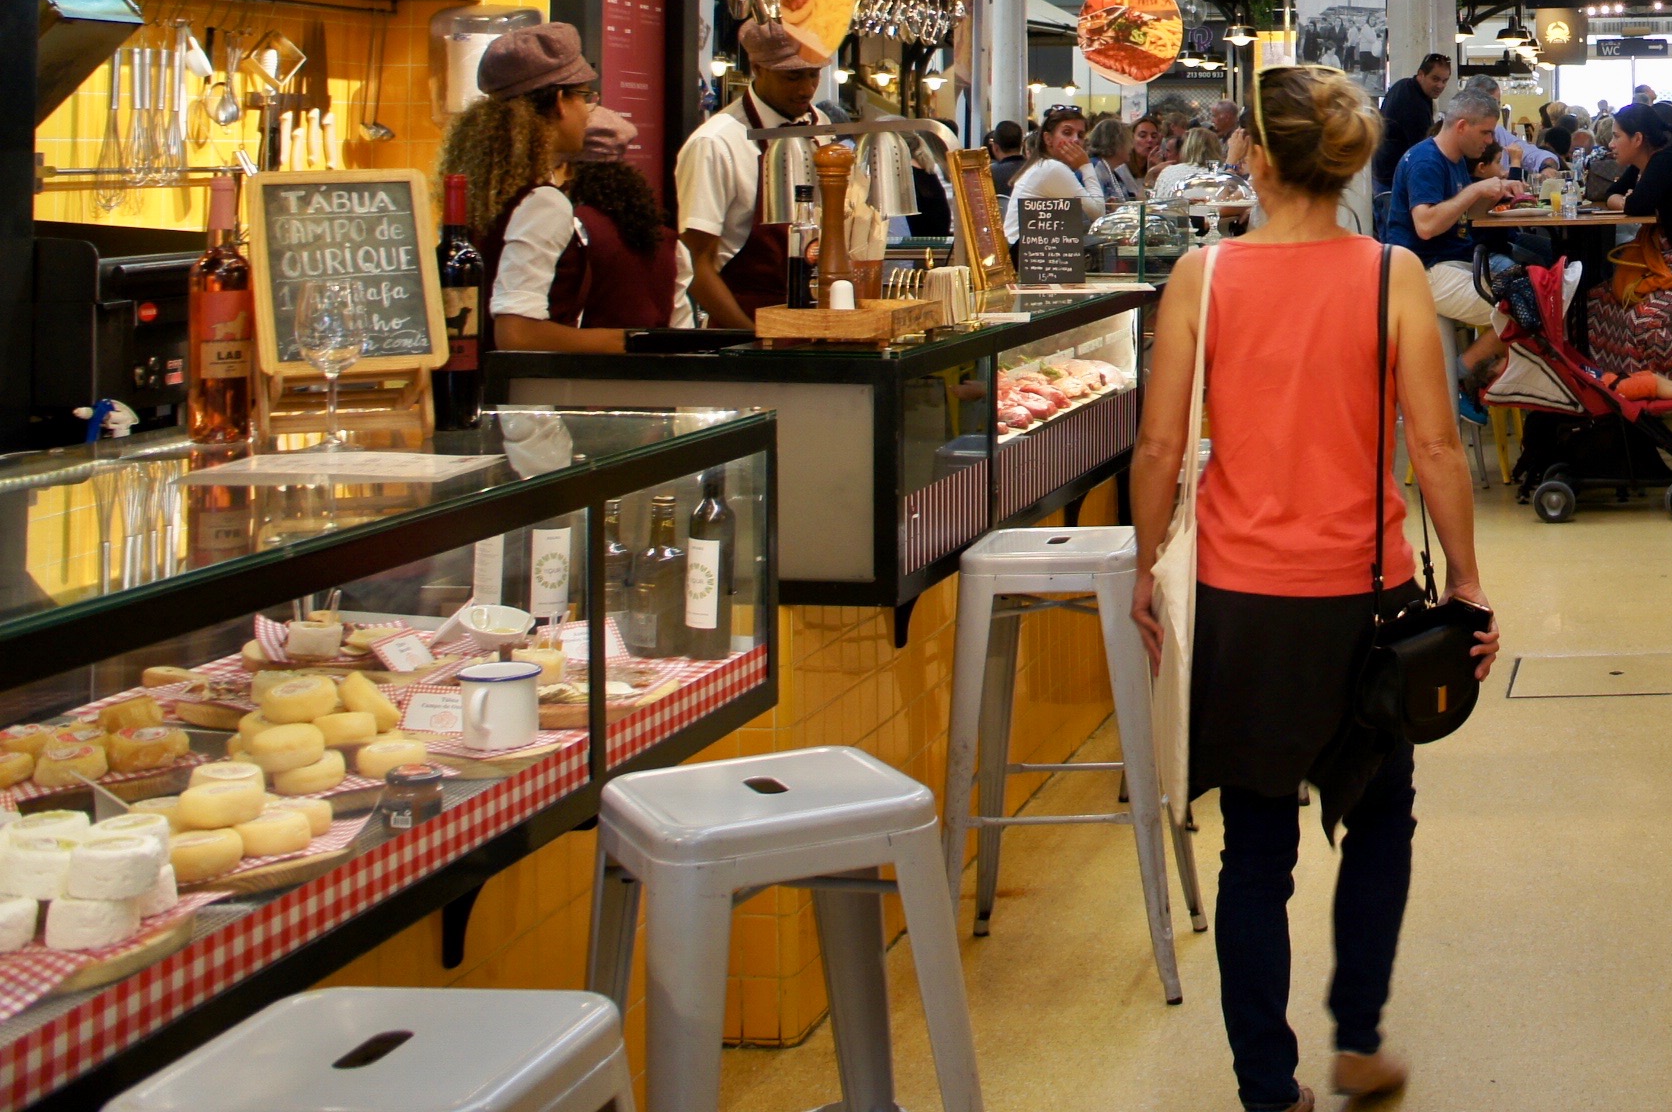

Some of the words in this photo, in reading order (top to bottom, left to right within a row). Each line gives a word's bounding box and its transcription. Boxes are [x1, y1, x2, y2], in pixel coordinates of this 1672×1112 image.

[1601, 45, 1621, 56] WC
[1186, 71, 1197, 79] 213
[1198, 71, 1211, 79] 900
[280, 185, 397, 214] TÁBUA
[1024, 198, 1071, 210] SUGESTÃO
[1038, 211, 1052, 219] DO
[275, 218, 367, 245] CAMPO
[375, 217, 406, 240] de
[1027, 220, 1065, 231] CHEF:
[1021, 235, 1049, 245] LOMBO
[281, 243, 417, 278] OURIQUE
[216, 350, 242, 361] LAB
